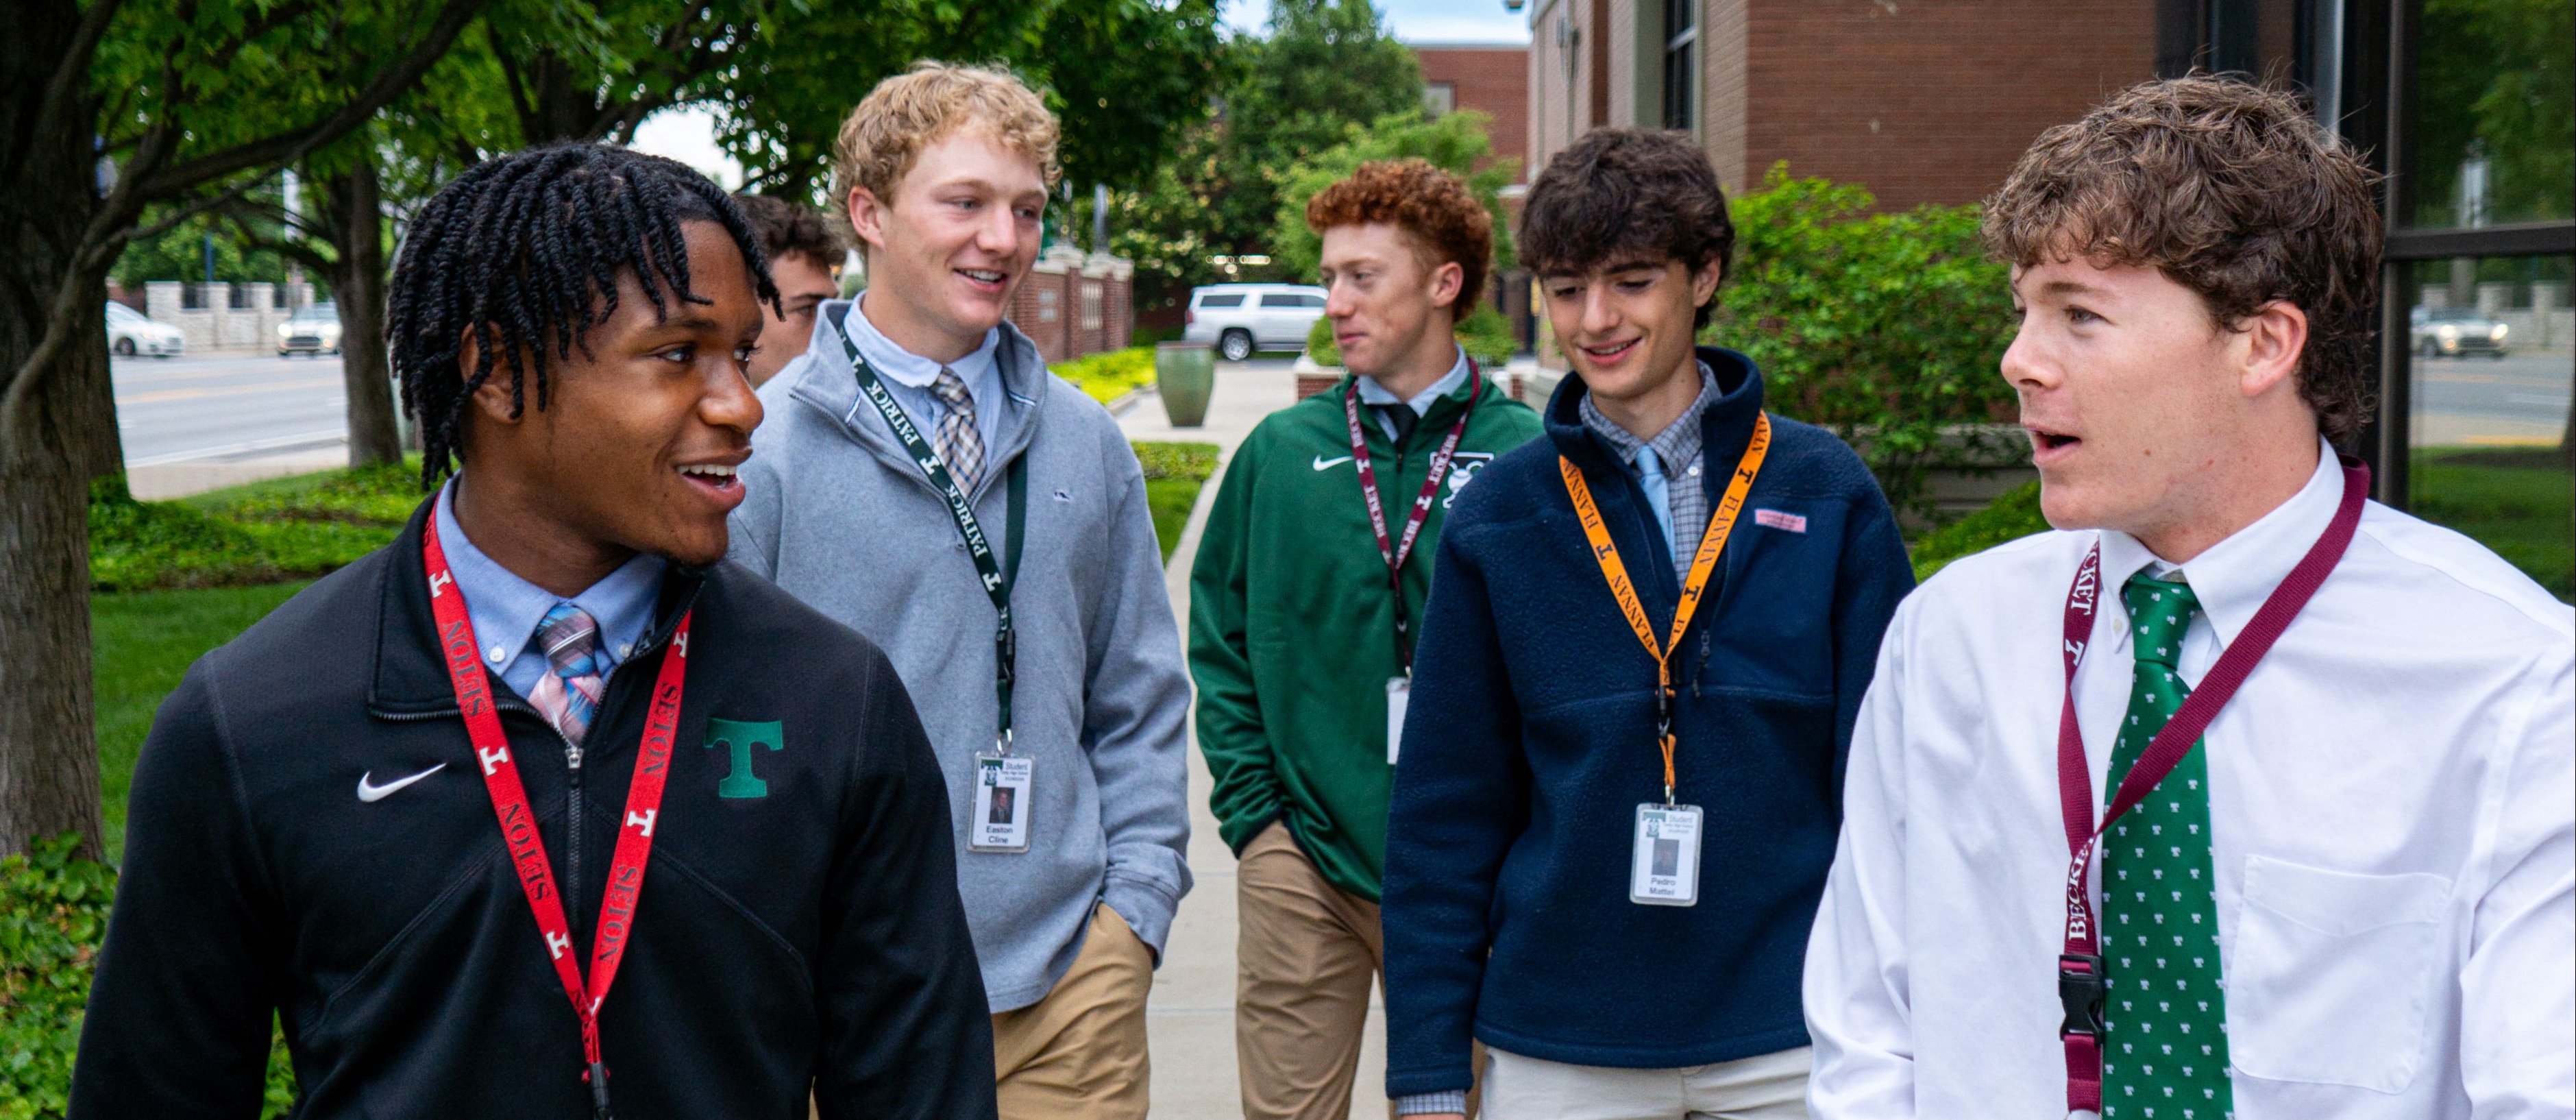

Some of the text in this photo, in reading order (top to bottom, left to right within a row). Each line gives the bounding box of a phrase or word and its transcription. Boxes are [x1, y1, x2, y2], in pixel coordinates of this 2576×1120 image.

[866, 380, 920, 446] PATRICK
[920, 456, 941, 475] T
[1739, 467, 1754, 484] T
[945, 483, 1002, 592] T PATRICK
[1699, 496, 1740, 566] FLANNAN
[1595, 544, 1613, 561] T
[1684, 585, 1700, 602] T
[2065, 638, 2085, 666] T
[428, 569, 508, 776] T SETON T
[643, 682, 678, 778] SETON
[703, 718, 783, 799] T
[626, 809, 657, 838] T
[986, 825, 1014, 834] Easton
[988, 835, 1009, 844] Cline
[500, 803, 569, 960] T SETON
[1650, 877, 1676, 886] Pedro
[598, 865, 640, 965] SETON
